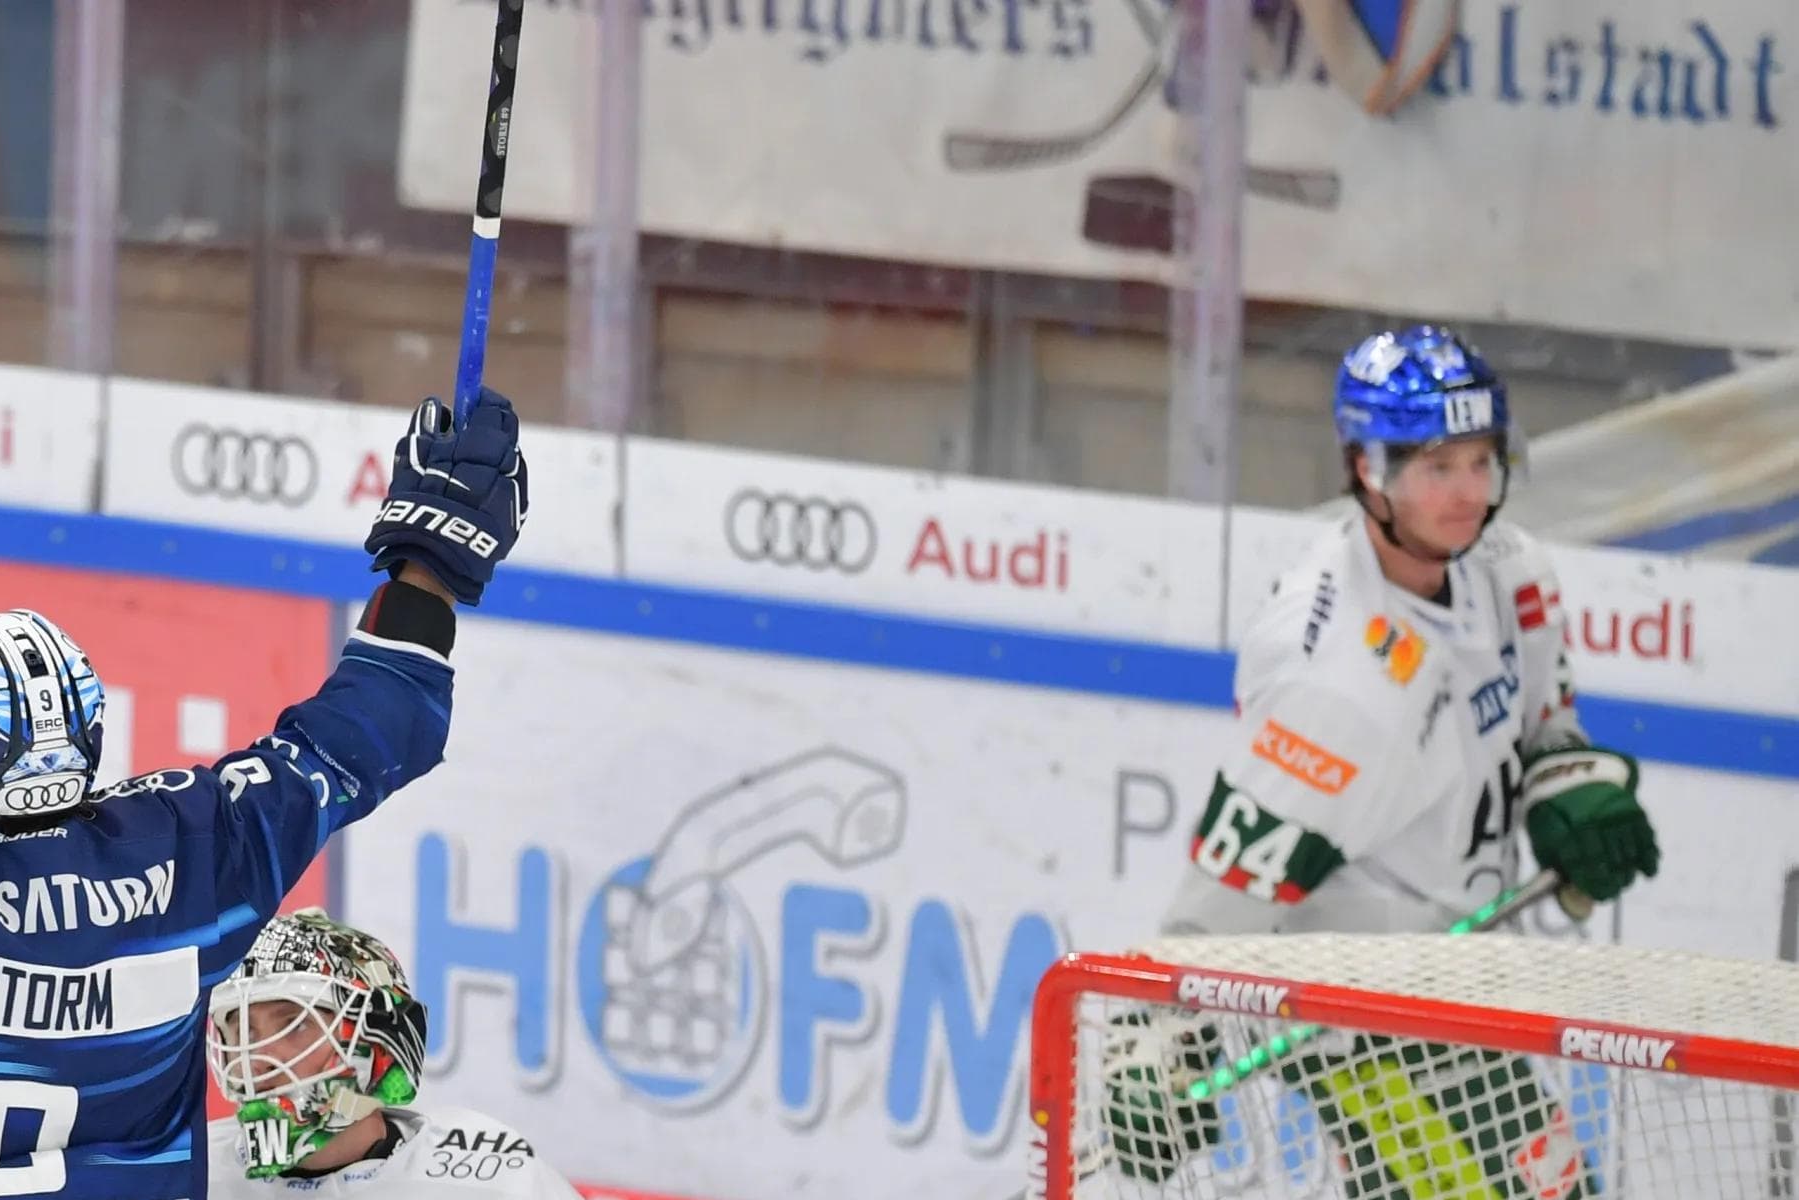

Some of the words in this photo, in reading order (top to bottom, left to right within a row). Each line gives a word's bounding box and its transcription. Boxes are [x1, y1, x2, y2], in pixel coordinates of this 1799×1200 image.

[906, 516, 1072, 594] Audi
[1560, 596, 1695, 664] udi
[40, 689, 54, 712] 9
[35, 717, 64, 731] ERC
[1202, 796, 1303, 898] 64
[435, 1129, 536, 1157] AHA
[425, 1153, 524, 1180] 360°
